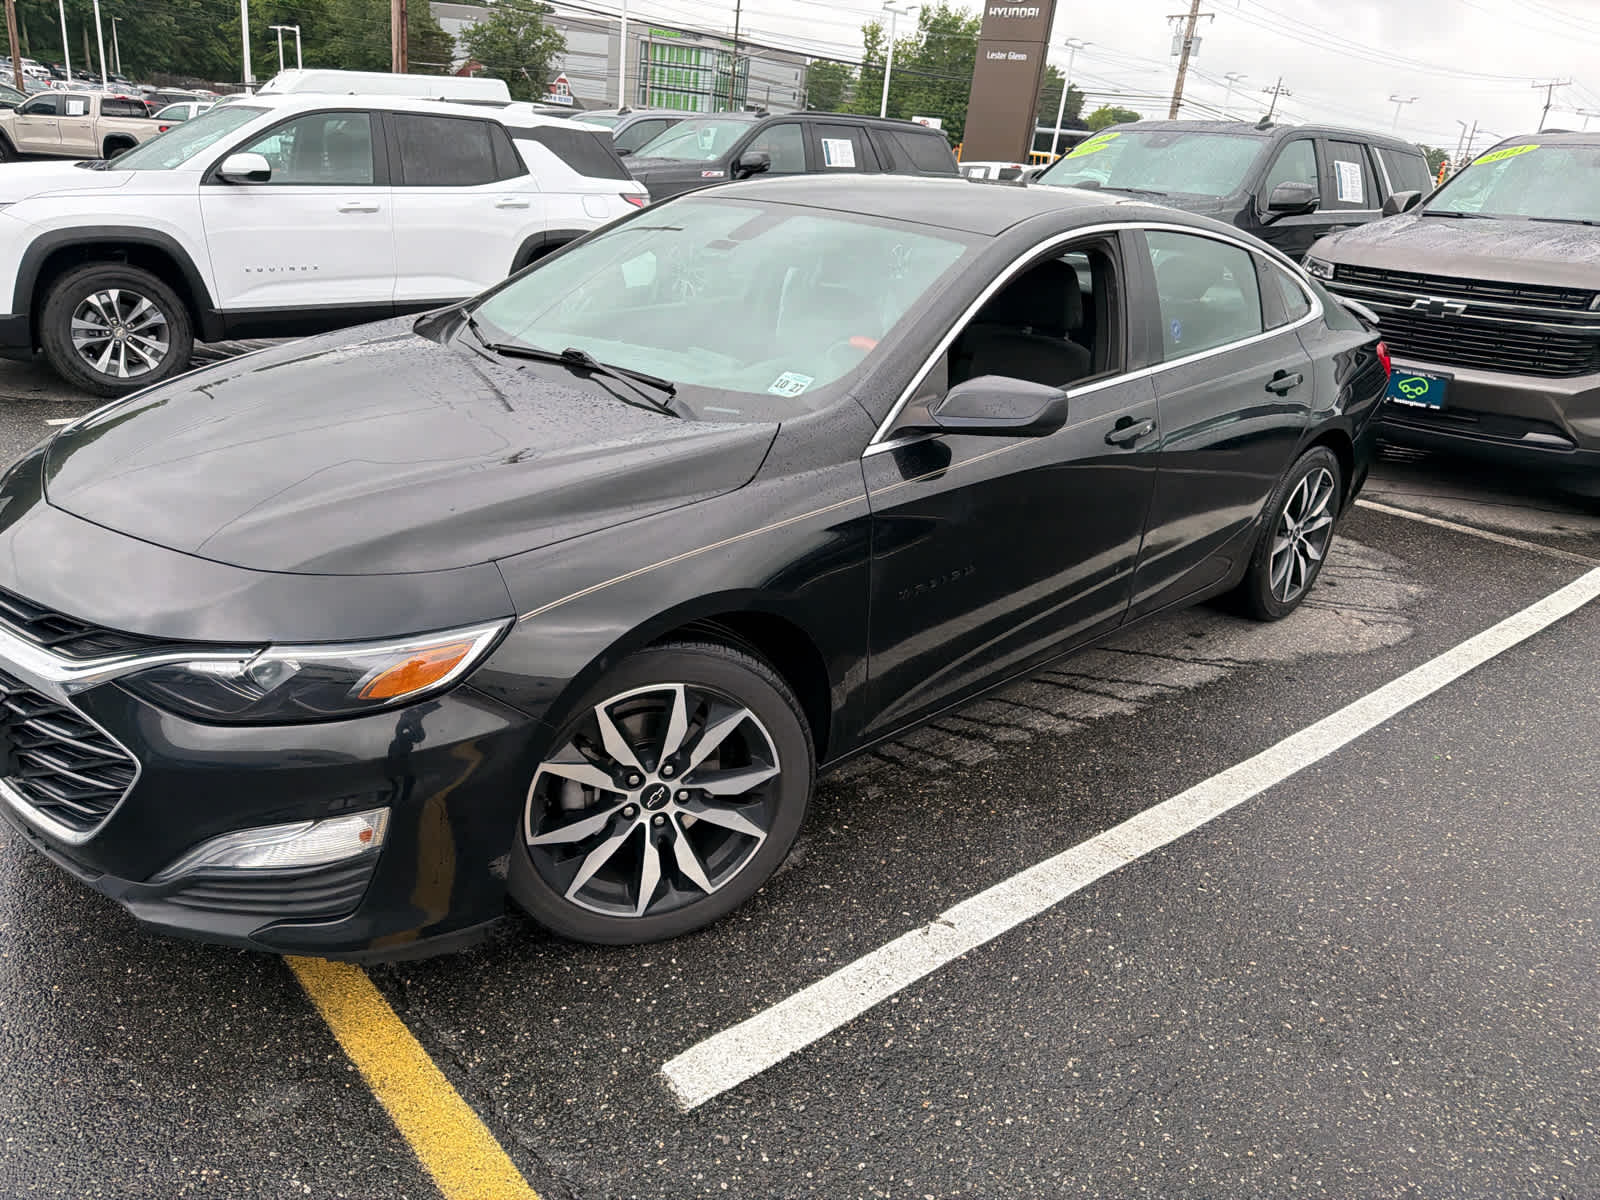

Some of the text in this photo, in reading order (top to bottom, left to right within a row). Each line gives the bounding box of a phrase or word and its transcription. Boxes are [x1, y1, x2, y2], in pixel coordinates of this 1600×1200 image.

[989, 7, 1040, 17] HYUNDAI
[986, 51, 1028, 61] Lester Glenn
[788, 383, 805, 393] 27
